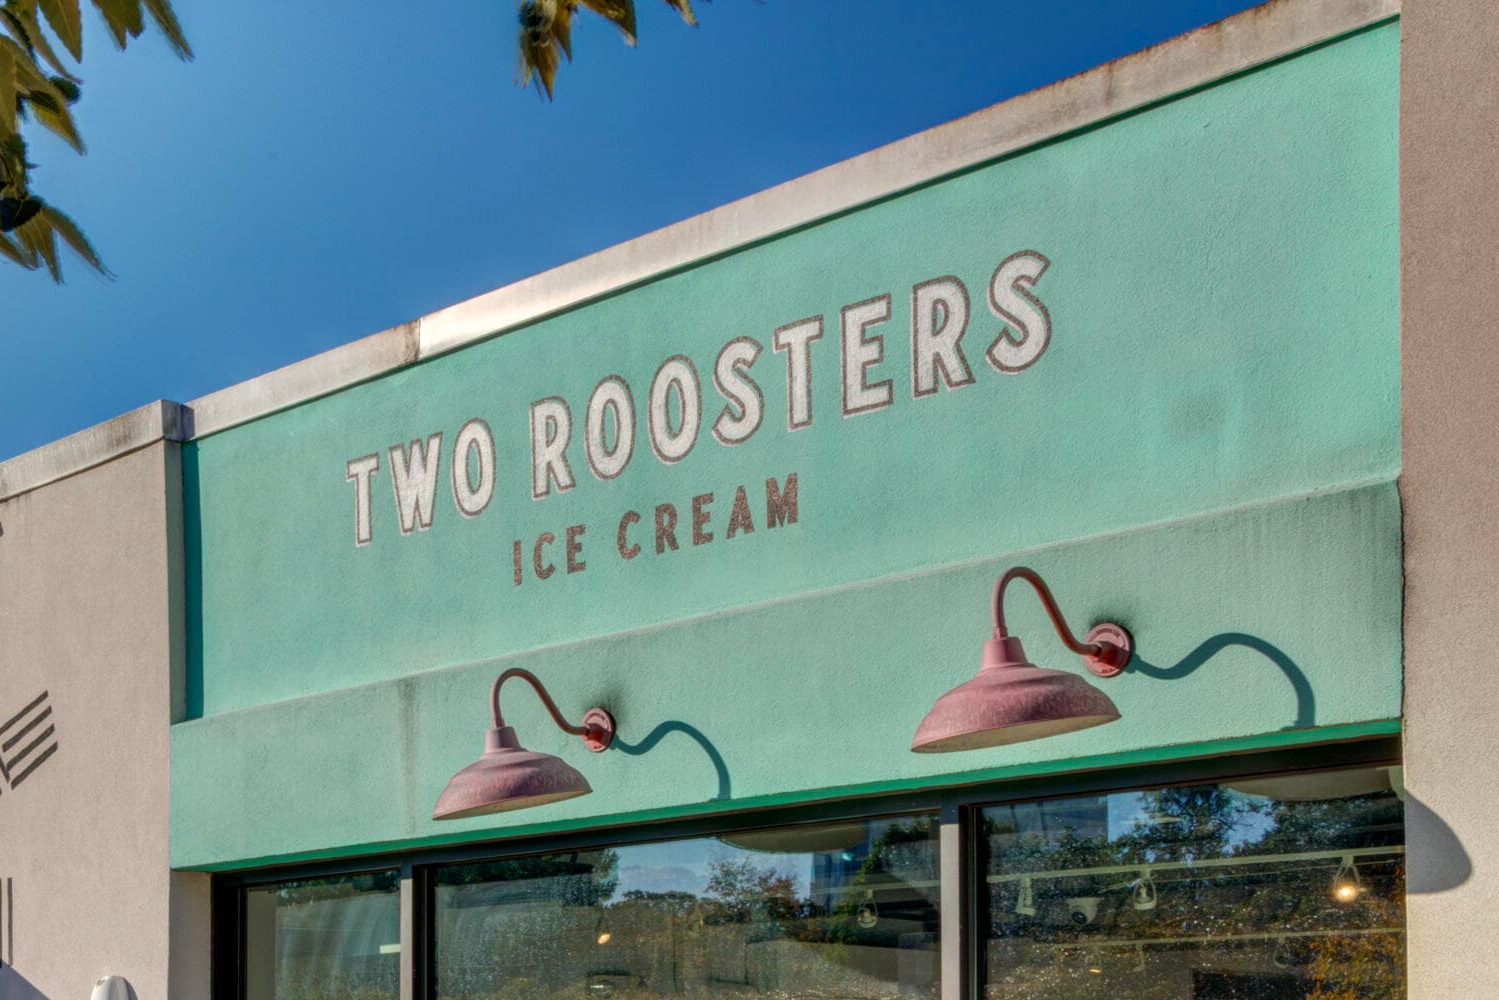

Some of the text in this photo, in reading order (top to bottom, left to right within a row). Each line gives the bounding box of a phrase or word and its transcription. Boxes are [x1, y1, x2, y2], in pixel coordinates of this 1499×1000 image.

[347, 250, 1051, 546] TWO ROOSTERS
[513, 472, 798, 586] ICE CREAM
